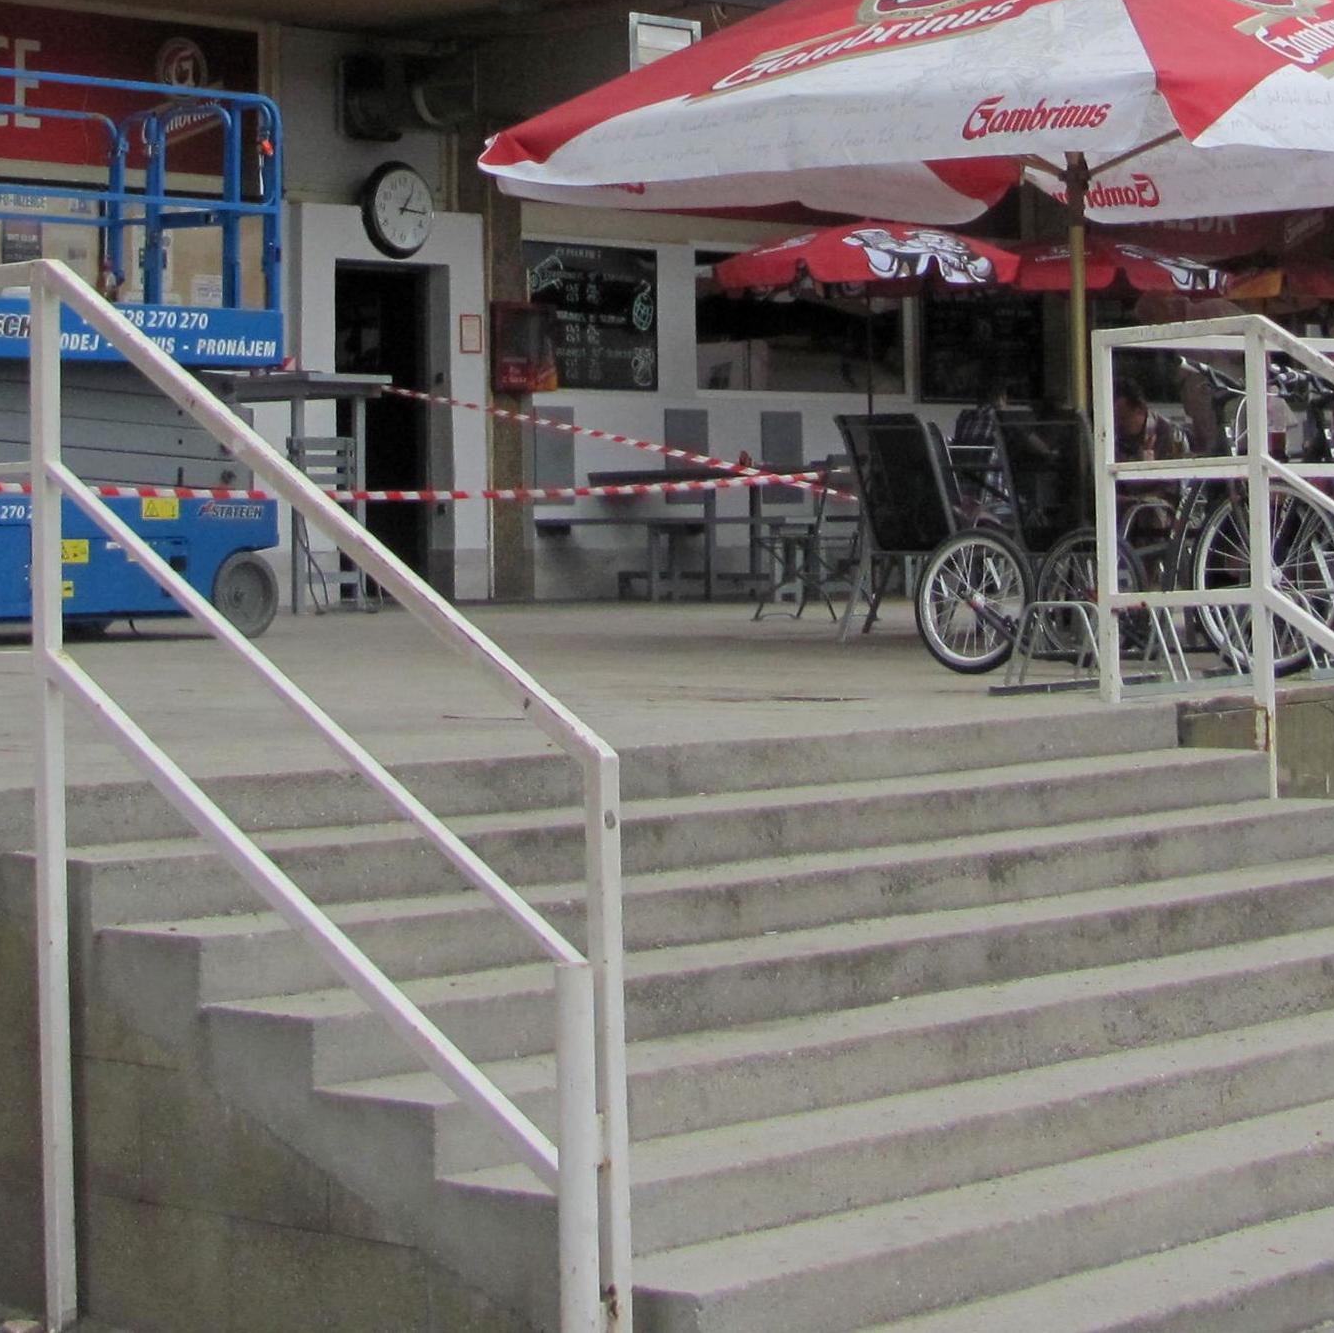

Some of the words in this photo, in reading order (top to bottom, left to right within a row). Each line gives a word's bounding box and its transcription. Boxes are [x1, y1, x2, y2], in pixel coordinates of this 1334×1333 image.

[962, 96, 1111, 140] Gambrinus
[147, 311, 177, 328] 270
[179, 311, 209, 329] 270
[60, 333, 99, 350] ODEJ
[197, 338, 277, 358] PRONÁJEM
[0, 506, 24, 520] 270
[211, 505, 262, 520] STATECH
